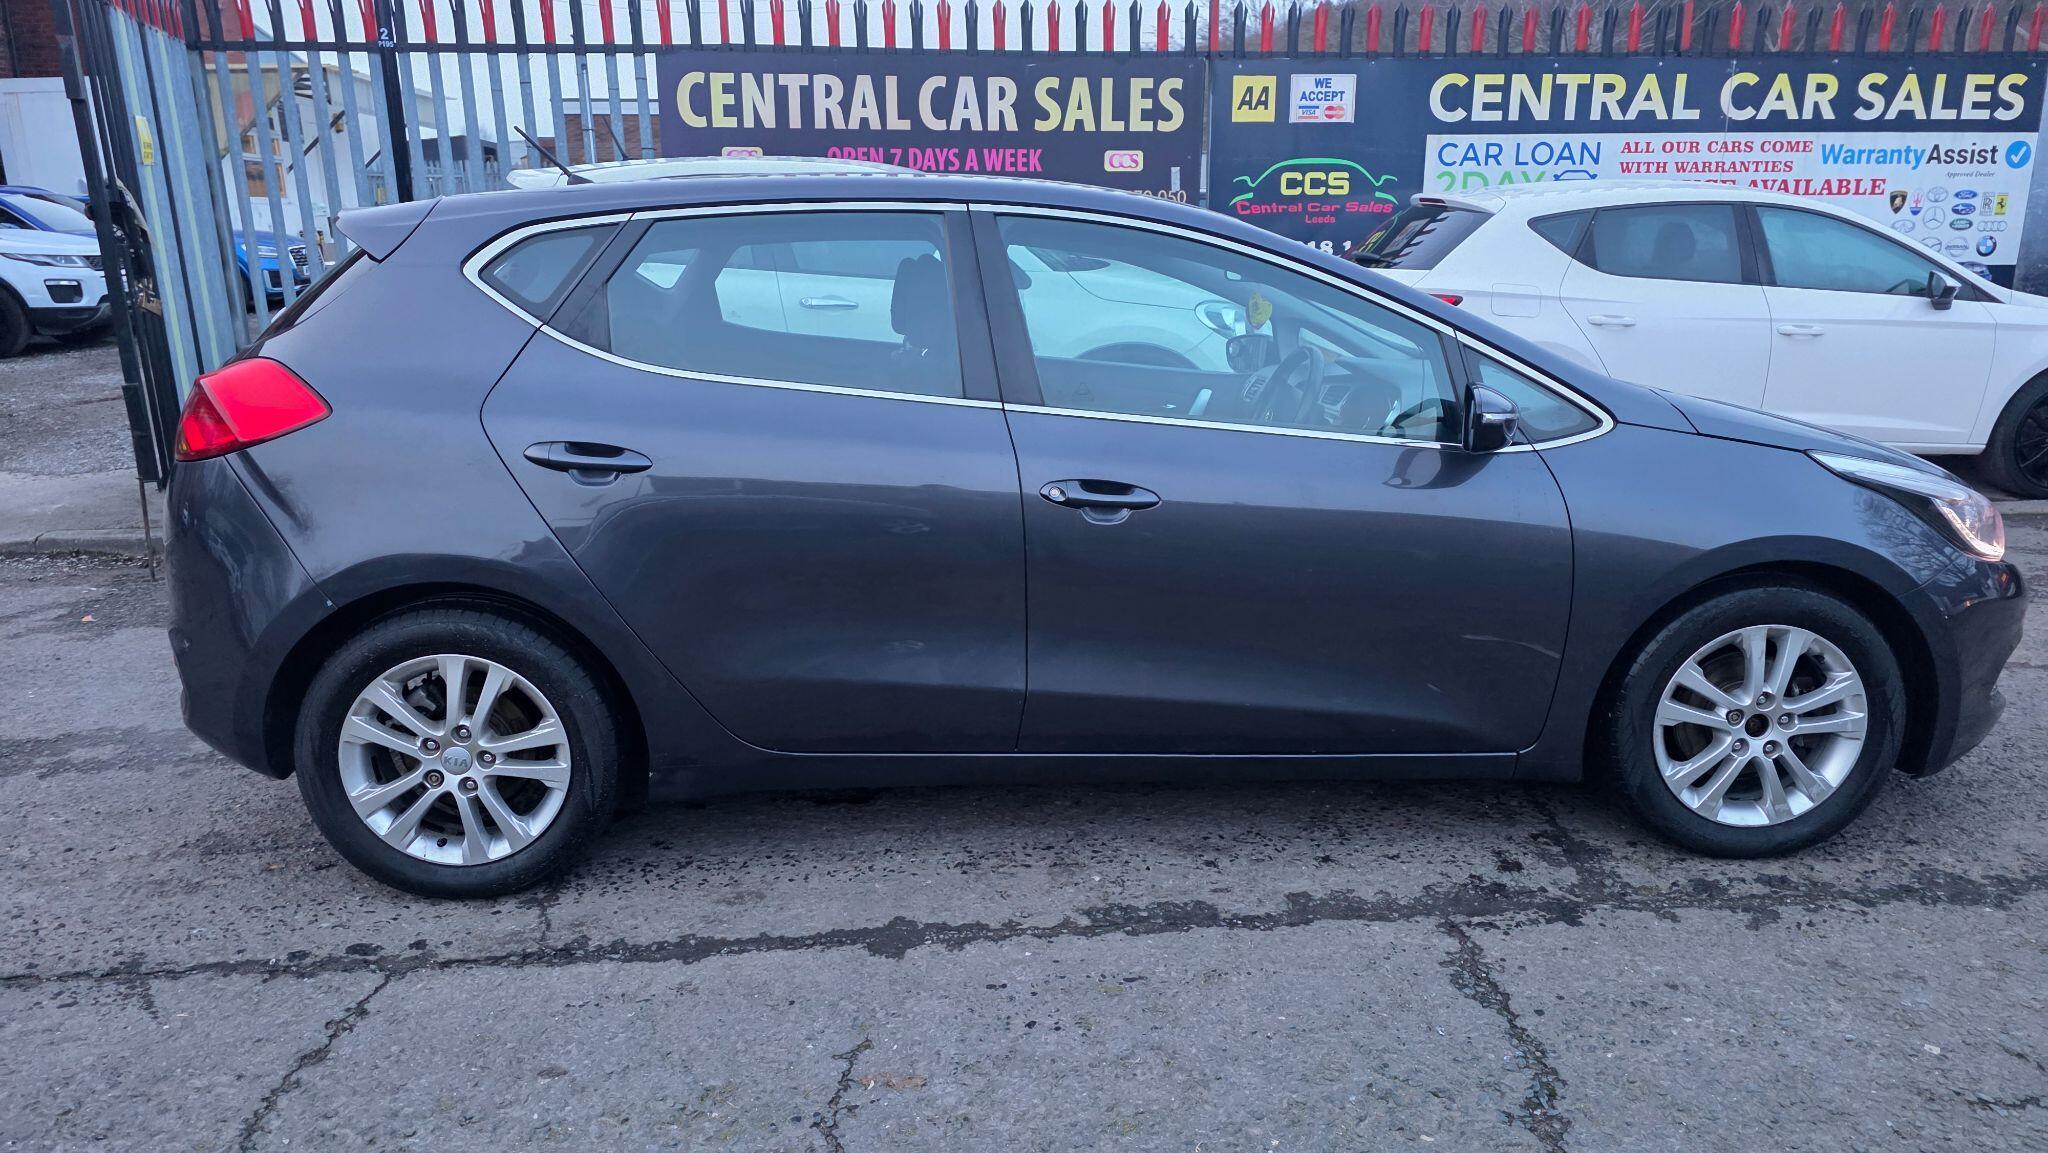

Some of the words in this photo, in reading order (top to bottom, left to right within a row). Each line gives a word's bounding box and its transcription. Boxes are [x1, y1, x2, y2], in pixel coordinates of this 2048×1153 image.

[380, 27, 389, 39] 2
[1314, 77, 1333, 89] WE
[676, 71, 911, 131] CENTRAL
[918, 75, 1018, 132] CAR
[1034, 76, 1185, 132] SALES
[1237, 86, 1270, 111] AA
[1300, 91, 1346, 102] ACCEPT
[1429, 73, 1700, 122] CENTRAL
[1720, 72, 1839, 121] CAR
[1853, 72, 2029, 121] SALES
[1437, 142, 1503, 167] CAR
[1515, 141, 1601, 166] LOAN
[1620, 141, 1655, 154] ALL
[1661, 141, 1700, 154] OUR
[1707, 140, 1754, 154] CARS
[1760, 140, 1814, 153] COME
[889, 148, 902, 167] 7
[908, 148, 960, 171] DAYS
[965, 148, 979, 171] A
[983, 148, 1043, 172] WEEK
[1619, 161, 1668, 174] WITH
[1674, 160, 1794, 174] WARRANTIES
[1280, 171, 1350, 196] CCS
[1236, 200, 1302, 215] Central
[1307, 202, 1341, 213] Car
[1345, 201, 1394, 214] Sales
[1305, 215, 1337, 225] Leeds
[443, 755, 469, 768] KIA
